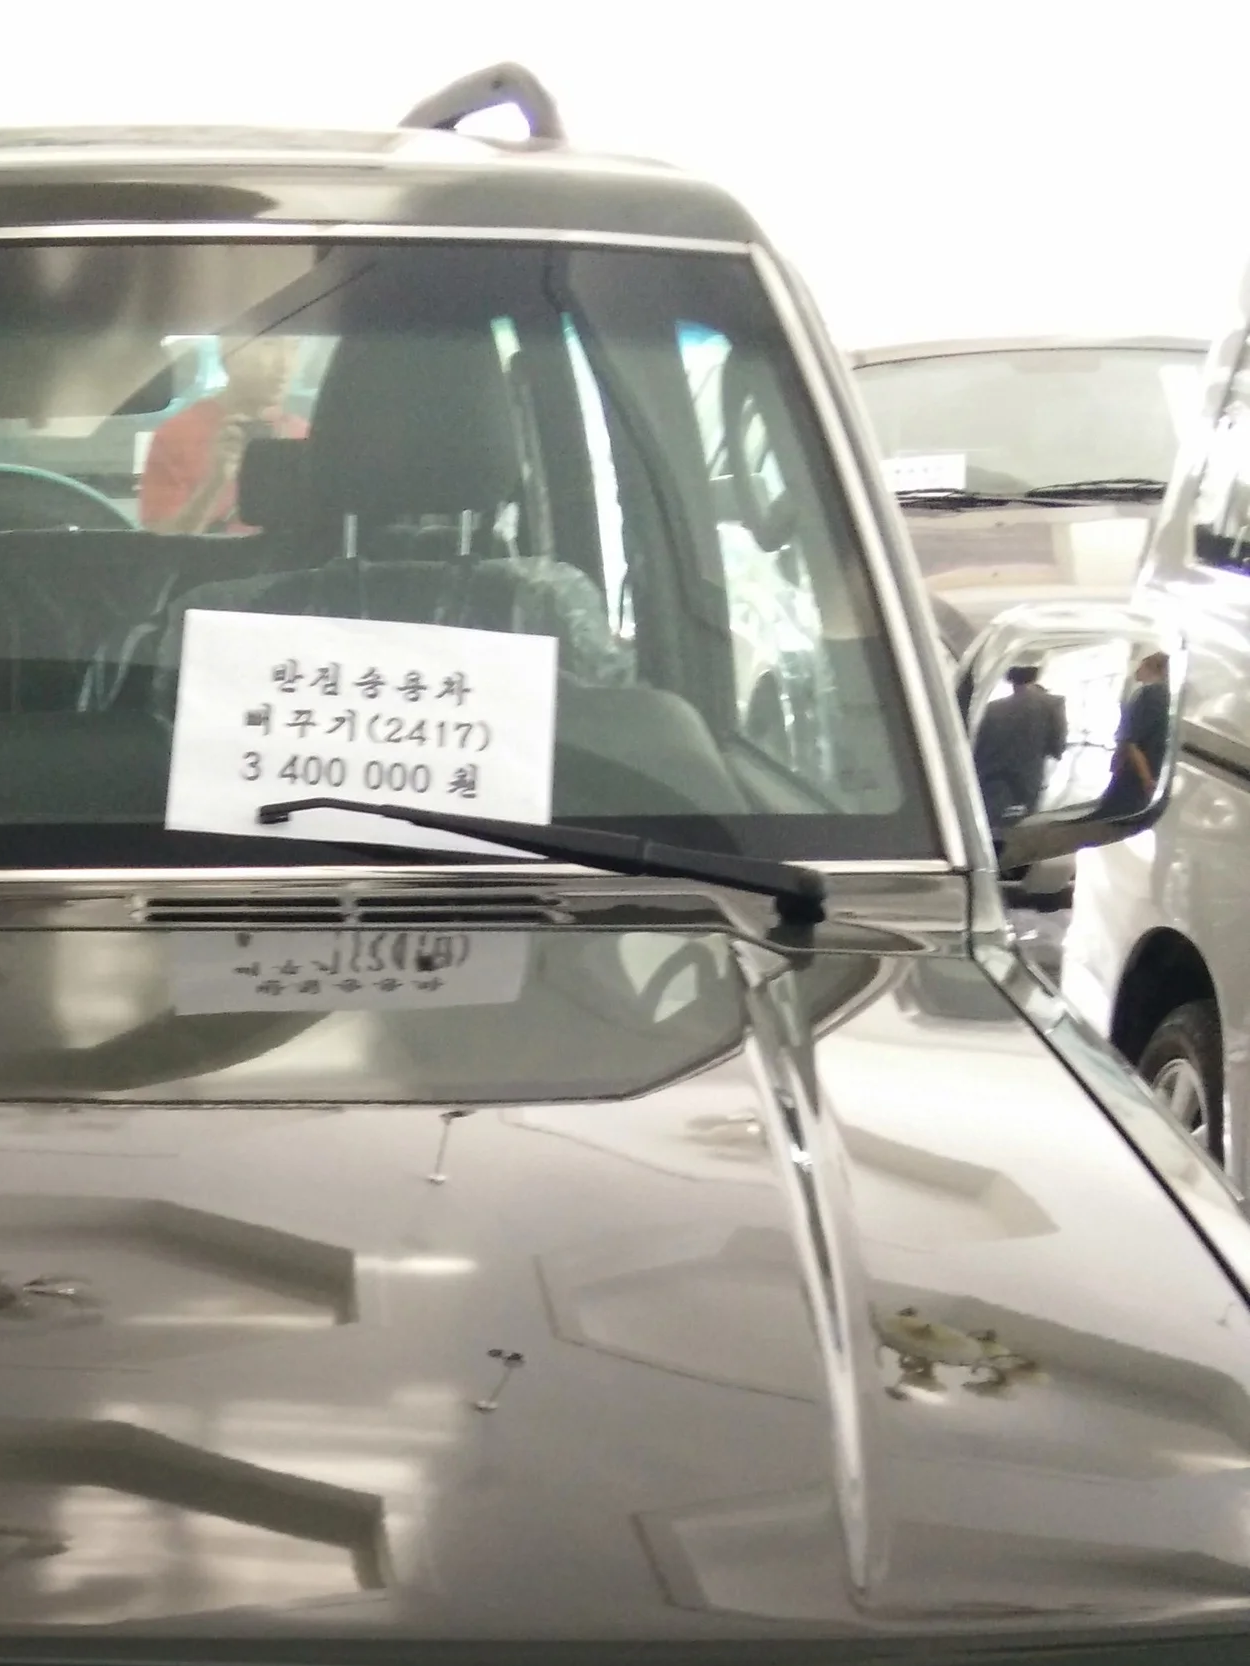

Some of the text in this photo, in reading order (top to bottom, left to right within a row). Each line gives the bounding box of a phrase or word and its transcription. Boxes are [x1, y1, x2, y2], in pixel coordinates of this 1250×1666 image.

[241, 752, 479, 798] 3 400 000 원
